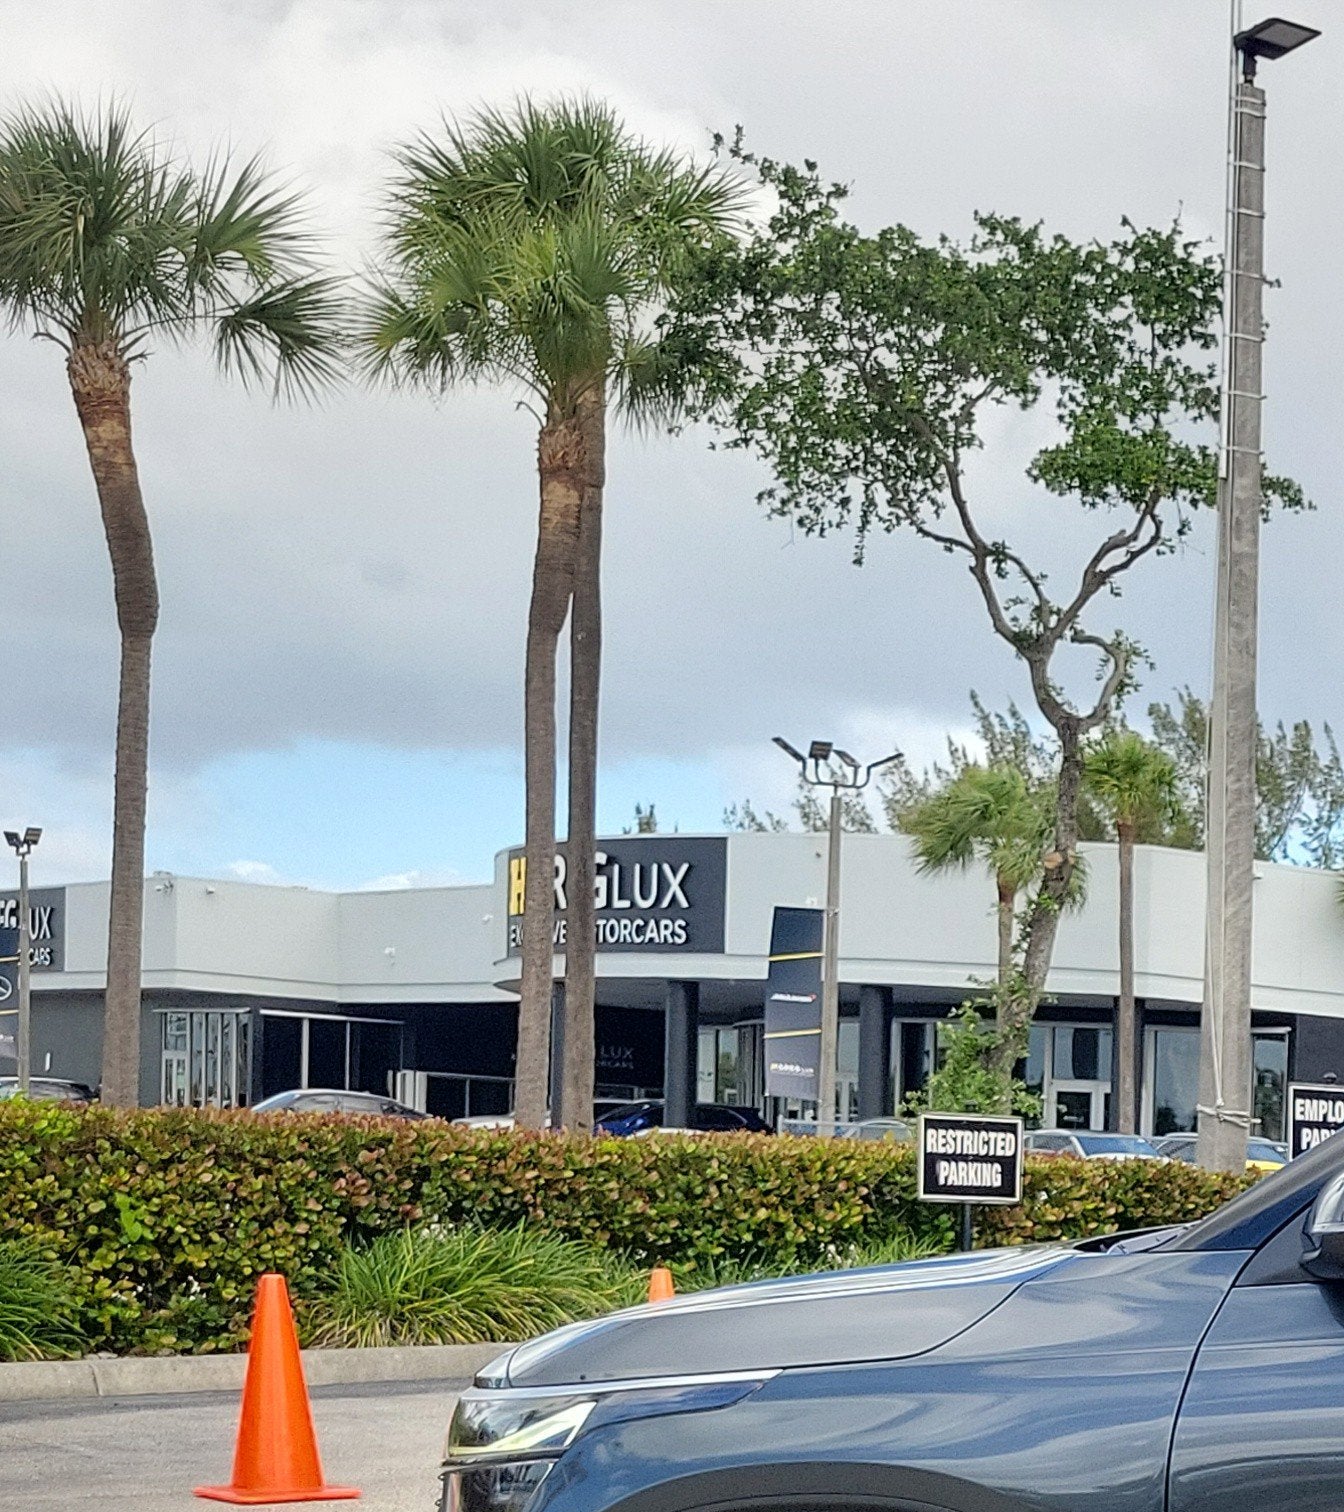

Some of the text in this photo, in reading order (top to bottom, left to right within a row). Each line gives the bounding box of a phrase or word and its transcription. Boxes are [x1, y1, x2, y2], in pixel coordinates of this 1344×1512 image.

[595, 919, 688, 945] TORCARS
[926, 1128, 1016, 1157] RESTRICTED
[936, 1160, 1002, 1188] PARKING
